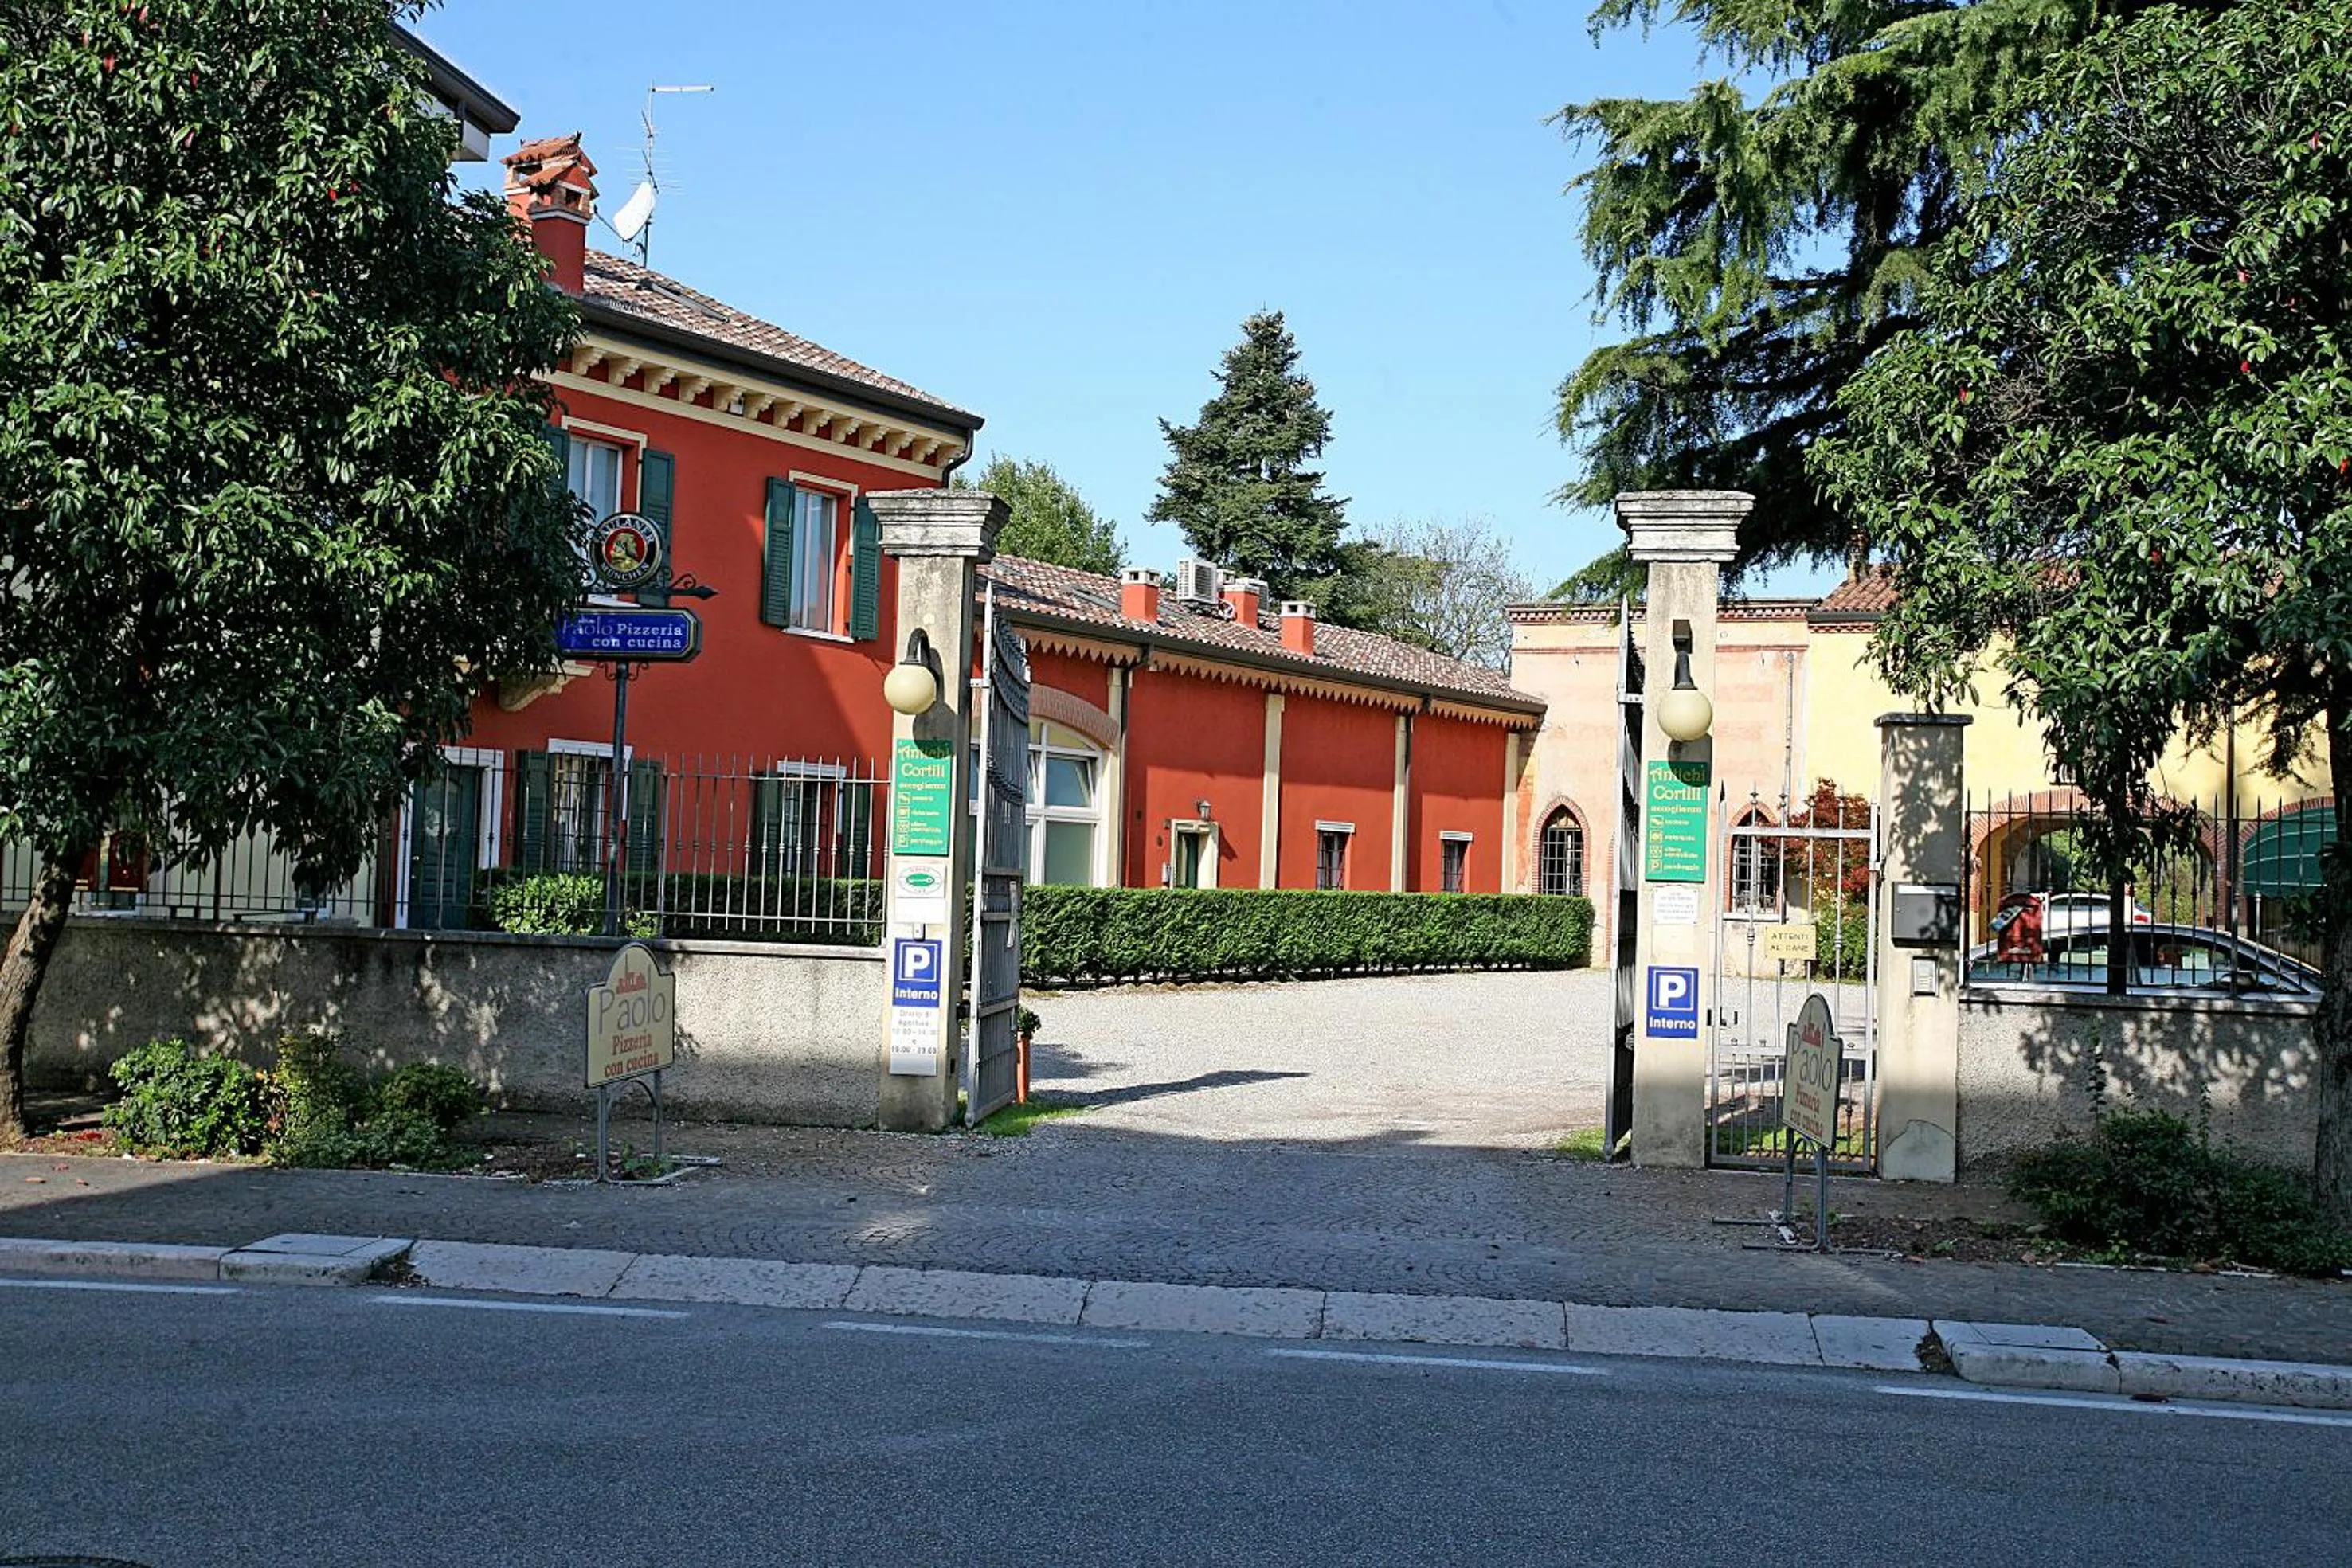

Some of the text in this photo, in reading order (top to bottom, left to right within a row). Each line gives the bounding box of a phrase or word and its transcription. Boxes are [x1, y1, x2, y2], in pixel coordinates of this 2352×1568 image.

[617, 624, 683, 636] Pizzeria
[592, 637, 682, 648] con cucina
[901, 762, 945, 777] Cortili
[1650, 767, 1705, 783] Antichi
[1653, 784, 1701, 800] Cortili
[904, 947, 930, 978] P
[895, 987, 938, 1000] Interno
[1658, 974, 1687, 1007] P
[599, 964, 666, 1034] Paolo
[1649, 1016, 1696, 1030] Interno
[612, 1029, 652, 1055] Pizzeria
[605, 1050, 659, 1077] con cucina
[1790, 1023, 1833, 1092] Paolo
